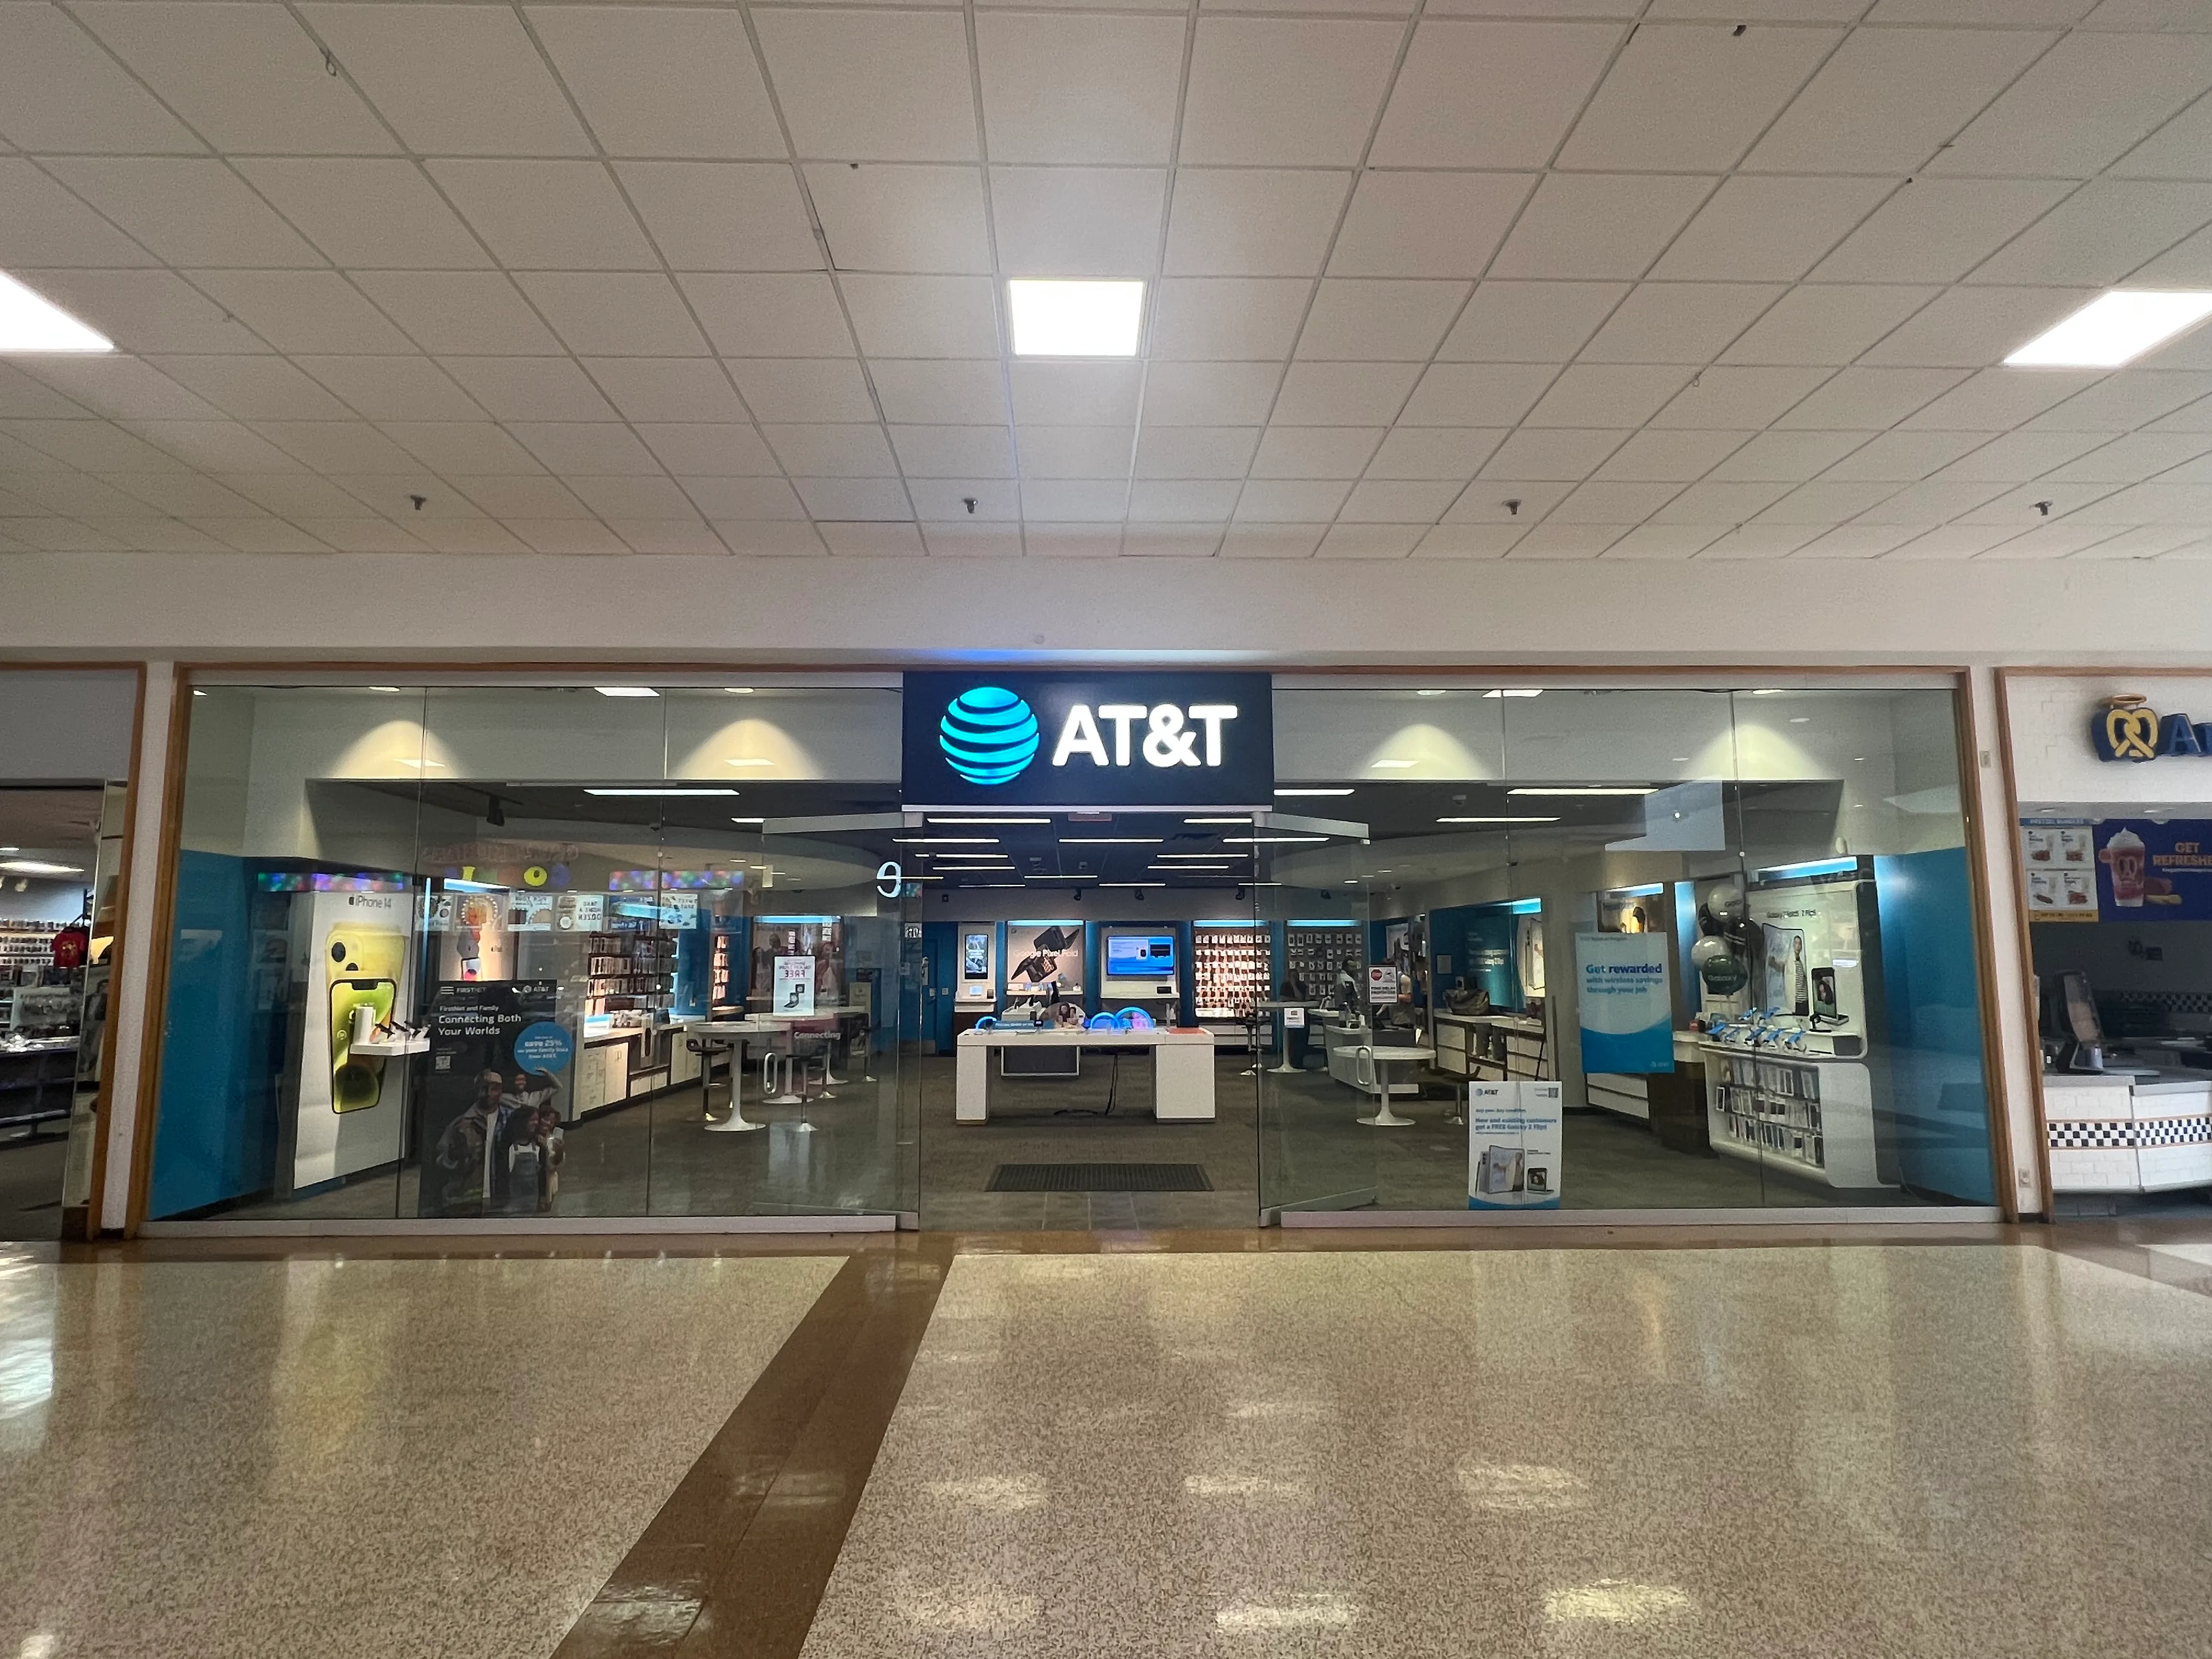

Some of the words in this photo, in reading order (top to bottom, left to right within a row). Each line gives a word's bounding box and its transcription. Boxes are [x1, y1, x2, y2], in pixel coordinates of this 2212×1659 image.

[1052, 703, 1238, 768] AT&T
[2175, 842, 2200, 853] GET
[356, 895, 383, 908] iPhone
[1585, 964, 1606, 974] Get
[1609, 963, 1662, 973] rewarded
[439, 1015, 494, 1024] Connecting
[498, 1014, 521, 1023] Both
[438, 1027, 461, 1036] Your
[465, 1026, 500, 1035] Worlds
